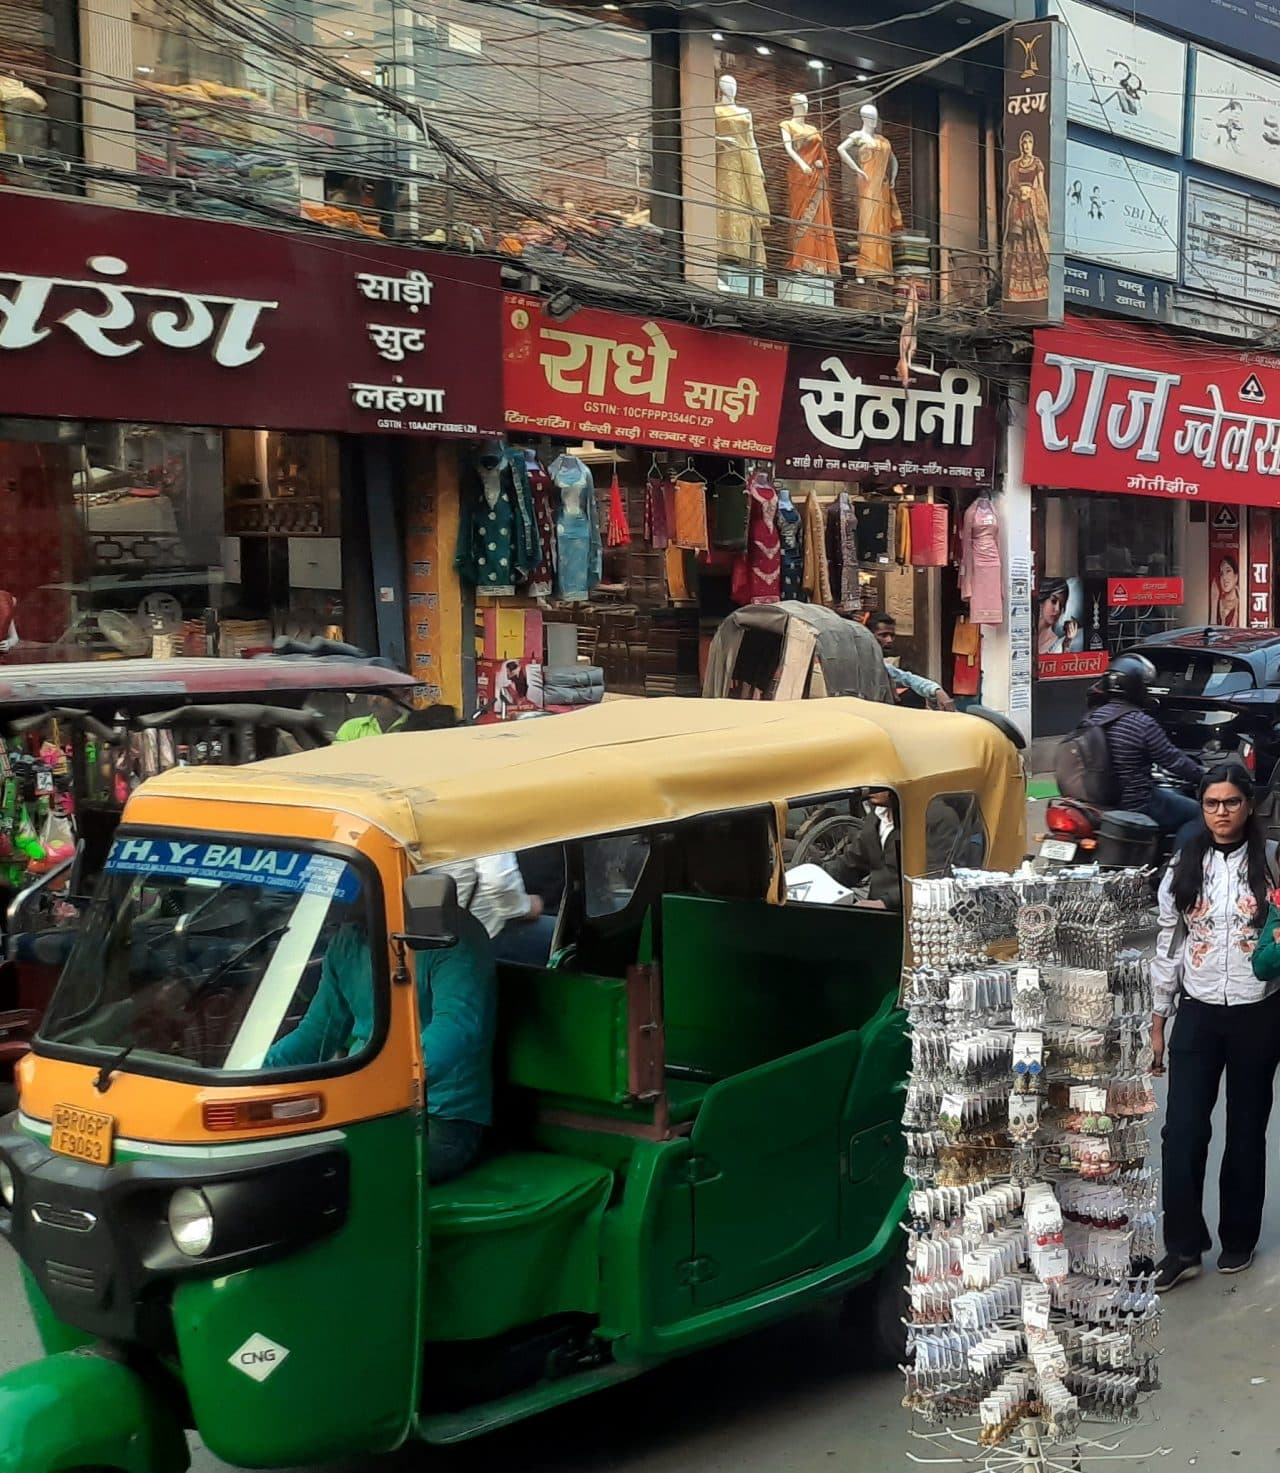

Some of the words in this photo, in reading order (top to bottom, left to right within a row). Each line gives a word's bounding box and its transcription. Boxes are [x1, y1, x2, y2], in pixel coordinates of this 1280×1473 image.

[1007, 87, 1049, 115] तरंग
[1123, 204, 1145, 221] SBI
[356, 270, 433, 313] साड़ी
[368, 324, 426, 361] सुट
[539, 321, 678, 404] राधे
[684, 377, 760, 423] साड़ी
[349, 375, 445, 413] लहंगा
[799, 356, 982, 451] सेठानी
[1036, 353, 1181, 462] राज
[1126, 474, 1200, 495] मोतीझील
[202, 844, 299, 876] BAJAJ
[241, 1349, 276, 1364] CNG
